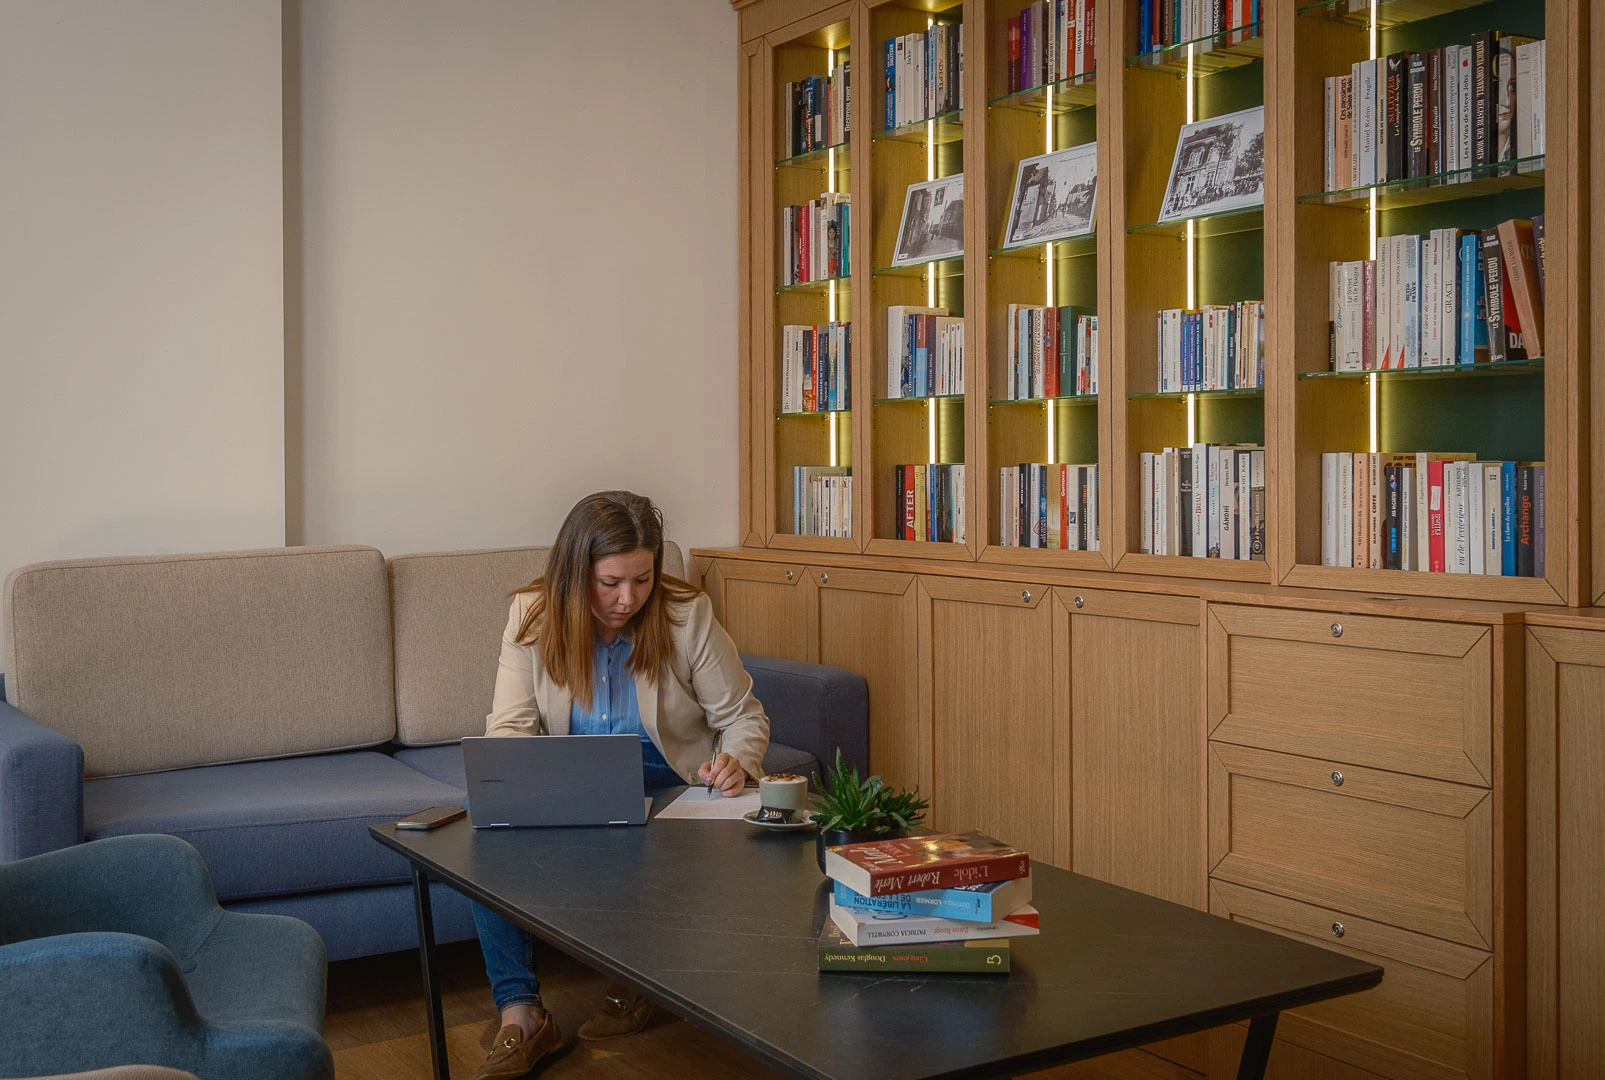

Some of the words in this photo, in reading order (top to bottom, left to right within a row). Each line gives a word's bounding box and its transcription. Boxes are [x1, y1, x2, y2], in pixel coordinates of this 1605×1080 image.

[1476, 41, 1485, 66] PATRICIA
[1476, 67, 1485, 97] CORNWELL
[1413, 82, 1423, 108] PERDU
[1449, 75, 1457, 105] empereur
[1450, 105, 1455, 115] un
[1463, 113, 1469, 123] de
[1410, 108, 1423, 147] SYMBOLE
[1487, 257, 1499, 283] PERDU
[1445, 279, 1453, 314] GRACE
[1488, 283, 1501, 323] SYMBOLE
[906, 489, 914, 528] AFTER
[1456, 503, 1465, 543] l'extérieur
[1519, 495, 1531, 545] Archange
[1456, 544, 1465, 554] de
[953, 865, 989, 879] L'idole
[874, 875, 905, 895] Merle
[907, 871, 940, 887] Robert
[854, 896, 899, 909] LIBÉRATION
[900, 894, 911, 903] DE
[915, 897, 942, 906] LORMIER
[900, 902, 912, 910] LA
[866, 930, 899, 939] CORNWELL
[900, 928, 926, 937] PATRICIA
[933, 925, 951, 935] Rouge
[823, 953, 855, 963] Kennedy
[857, 953, 886, 963] Douglas
[892, 955, 910, 963] jours
[910, 954, 929, 963] Cinq
